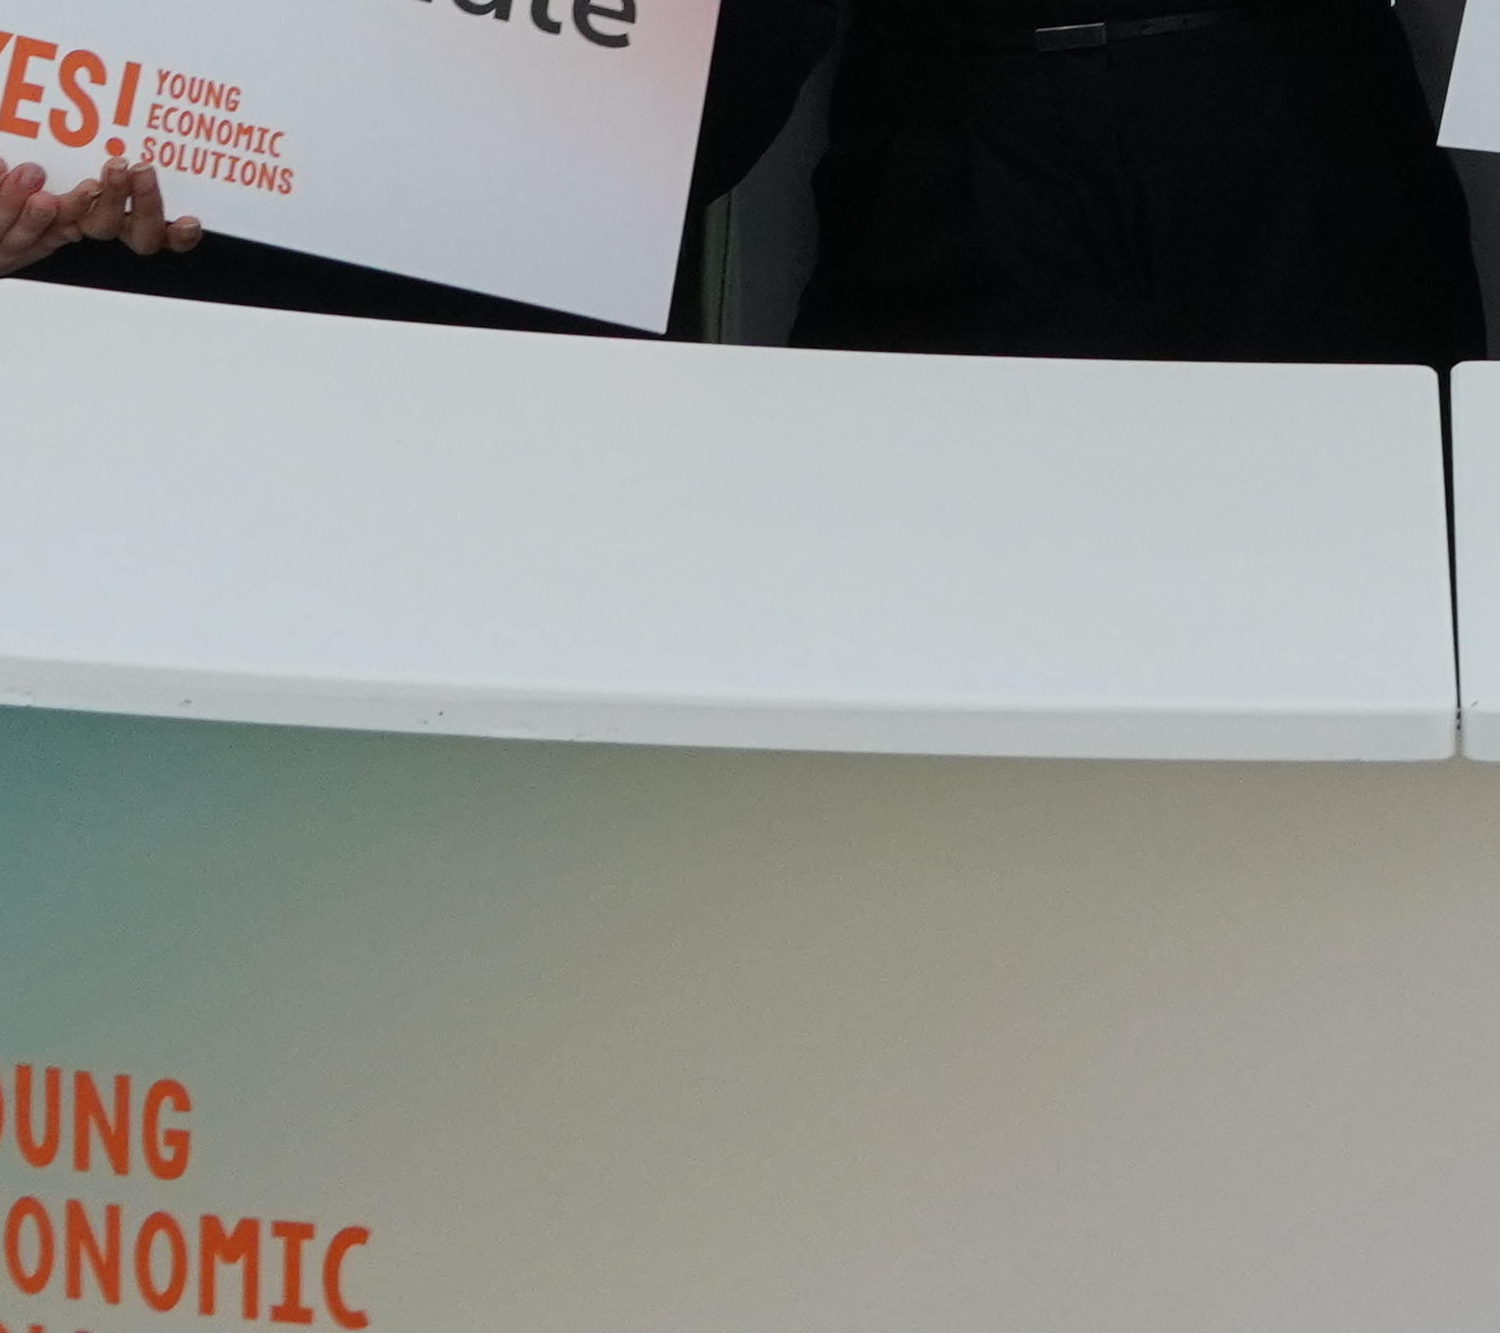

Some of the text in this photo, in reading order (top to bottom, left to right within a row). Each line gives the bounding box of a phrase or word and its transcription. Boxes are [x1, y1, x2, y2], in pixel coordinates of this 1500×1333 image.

[155, 68, 242, 113] YOUNG
[146, 103, 286, 159] ECONOMIC
[139, 137, 296, 196] SOLUTIONS
